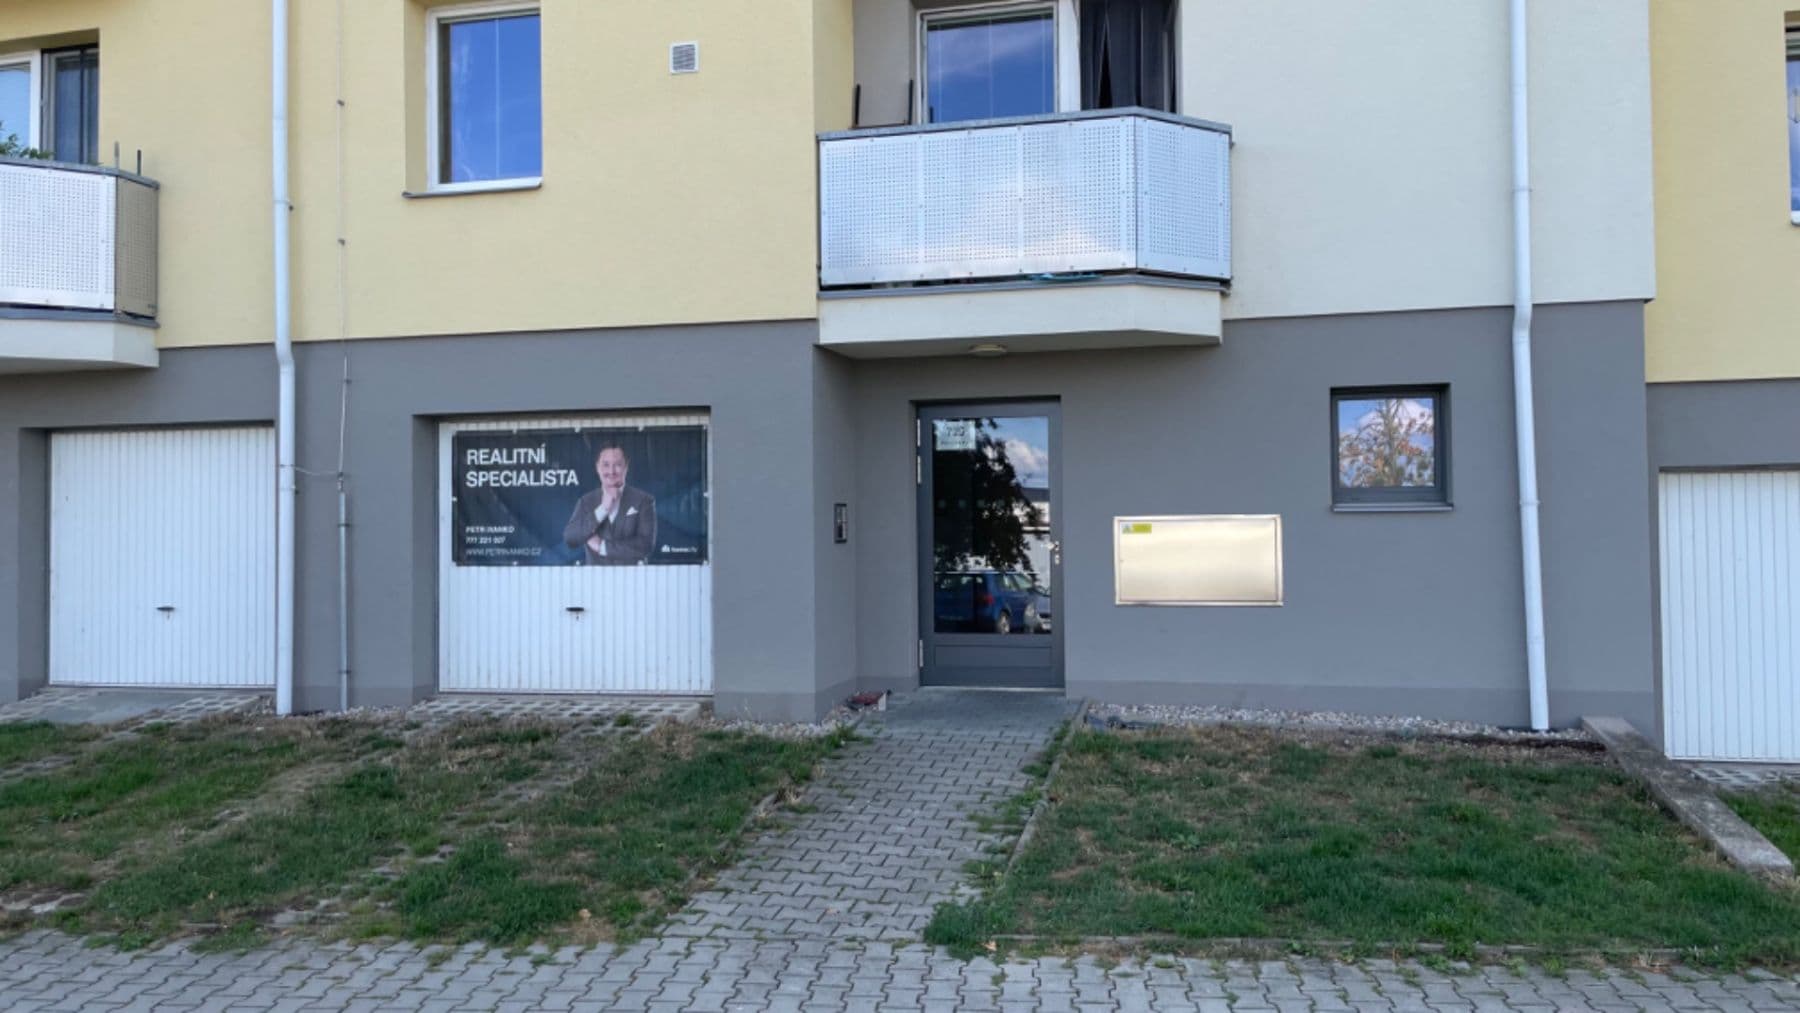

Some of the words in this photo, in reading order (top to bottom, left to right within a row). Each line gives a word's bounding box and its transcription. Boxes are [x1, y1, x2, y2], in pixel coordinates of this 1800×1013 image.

[466, 442, 546, 465] REALITNÍ
[465, 469, 579, 487] SPECIALISTA
[465, 526, 485, 534] PETR
